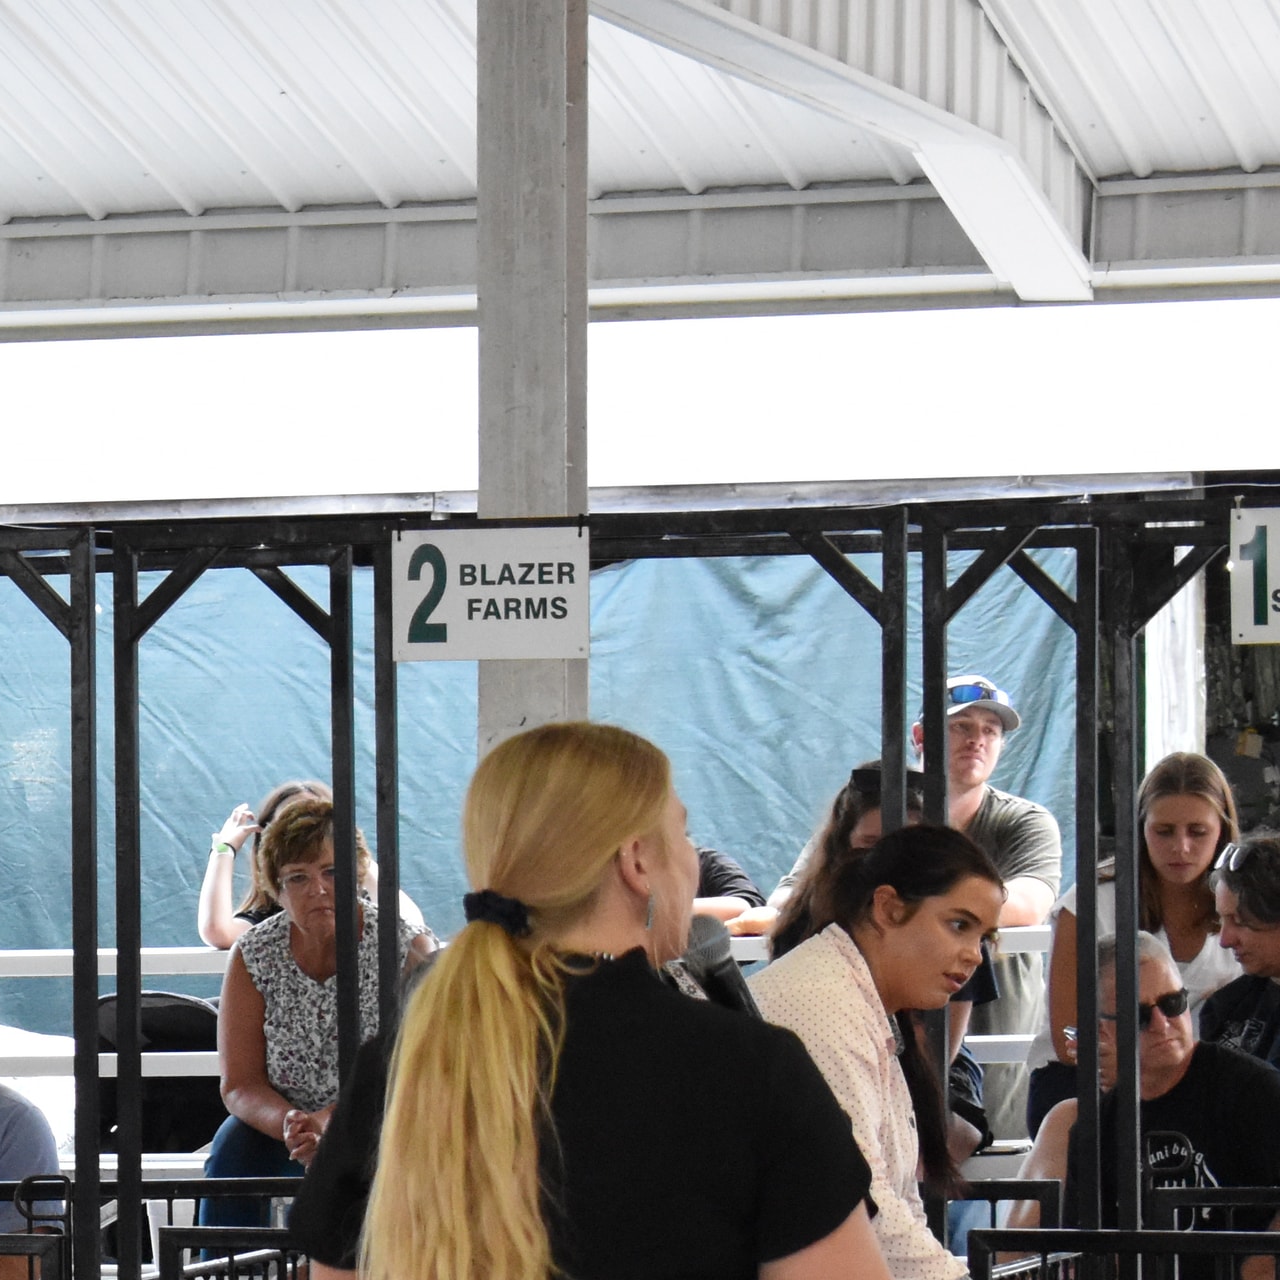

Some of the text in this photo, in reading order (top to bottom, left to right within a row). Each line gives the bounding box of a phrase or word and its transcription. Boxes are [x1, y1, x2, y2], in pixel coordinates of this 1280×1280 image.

[407, 543, 448, 644] 2
[459, 562, 575, 587] BLAZER
[1239, 525, 1269, 626] 1
[467, 596, 568, 621] FARMS
